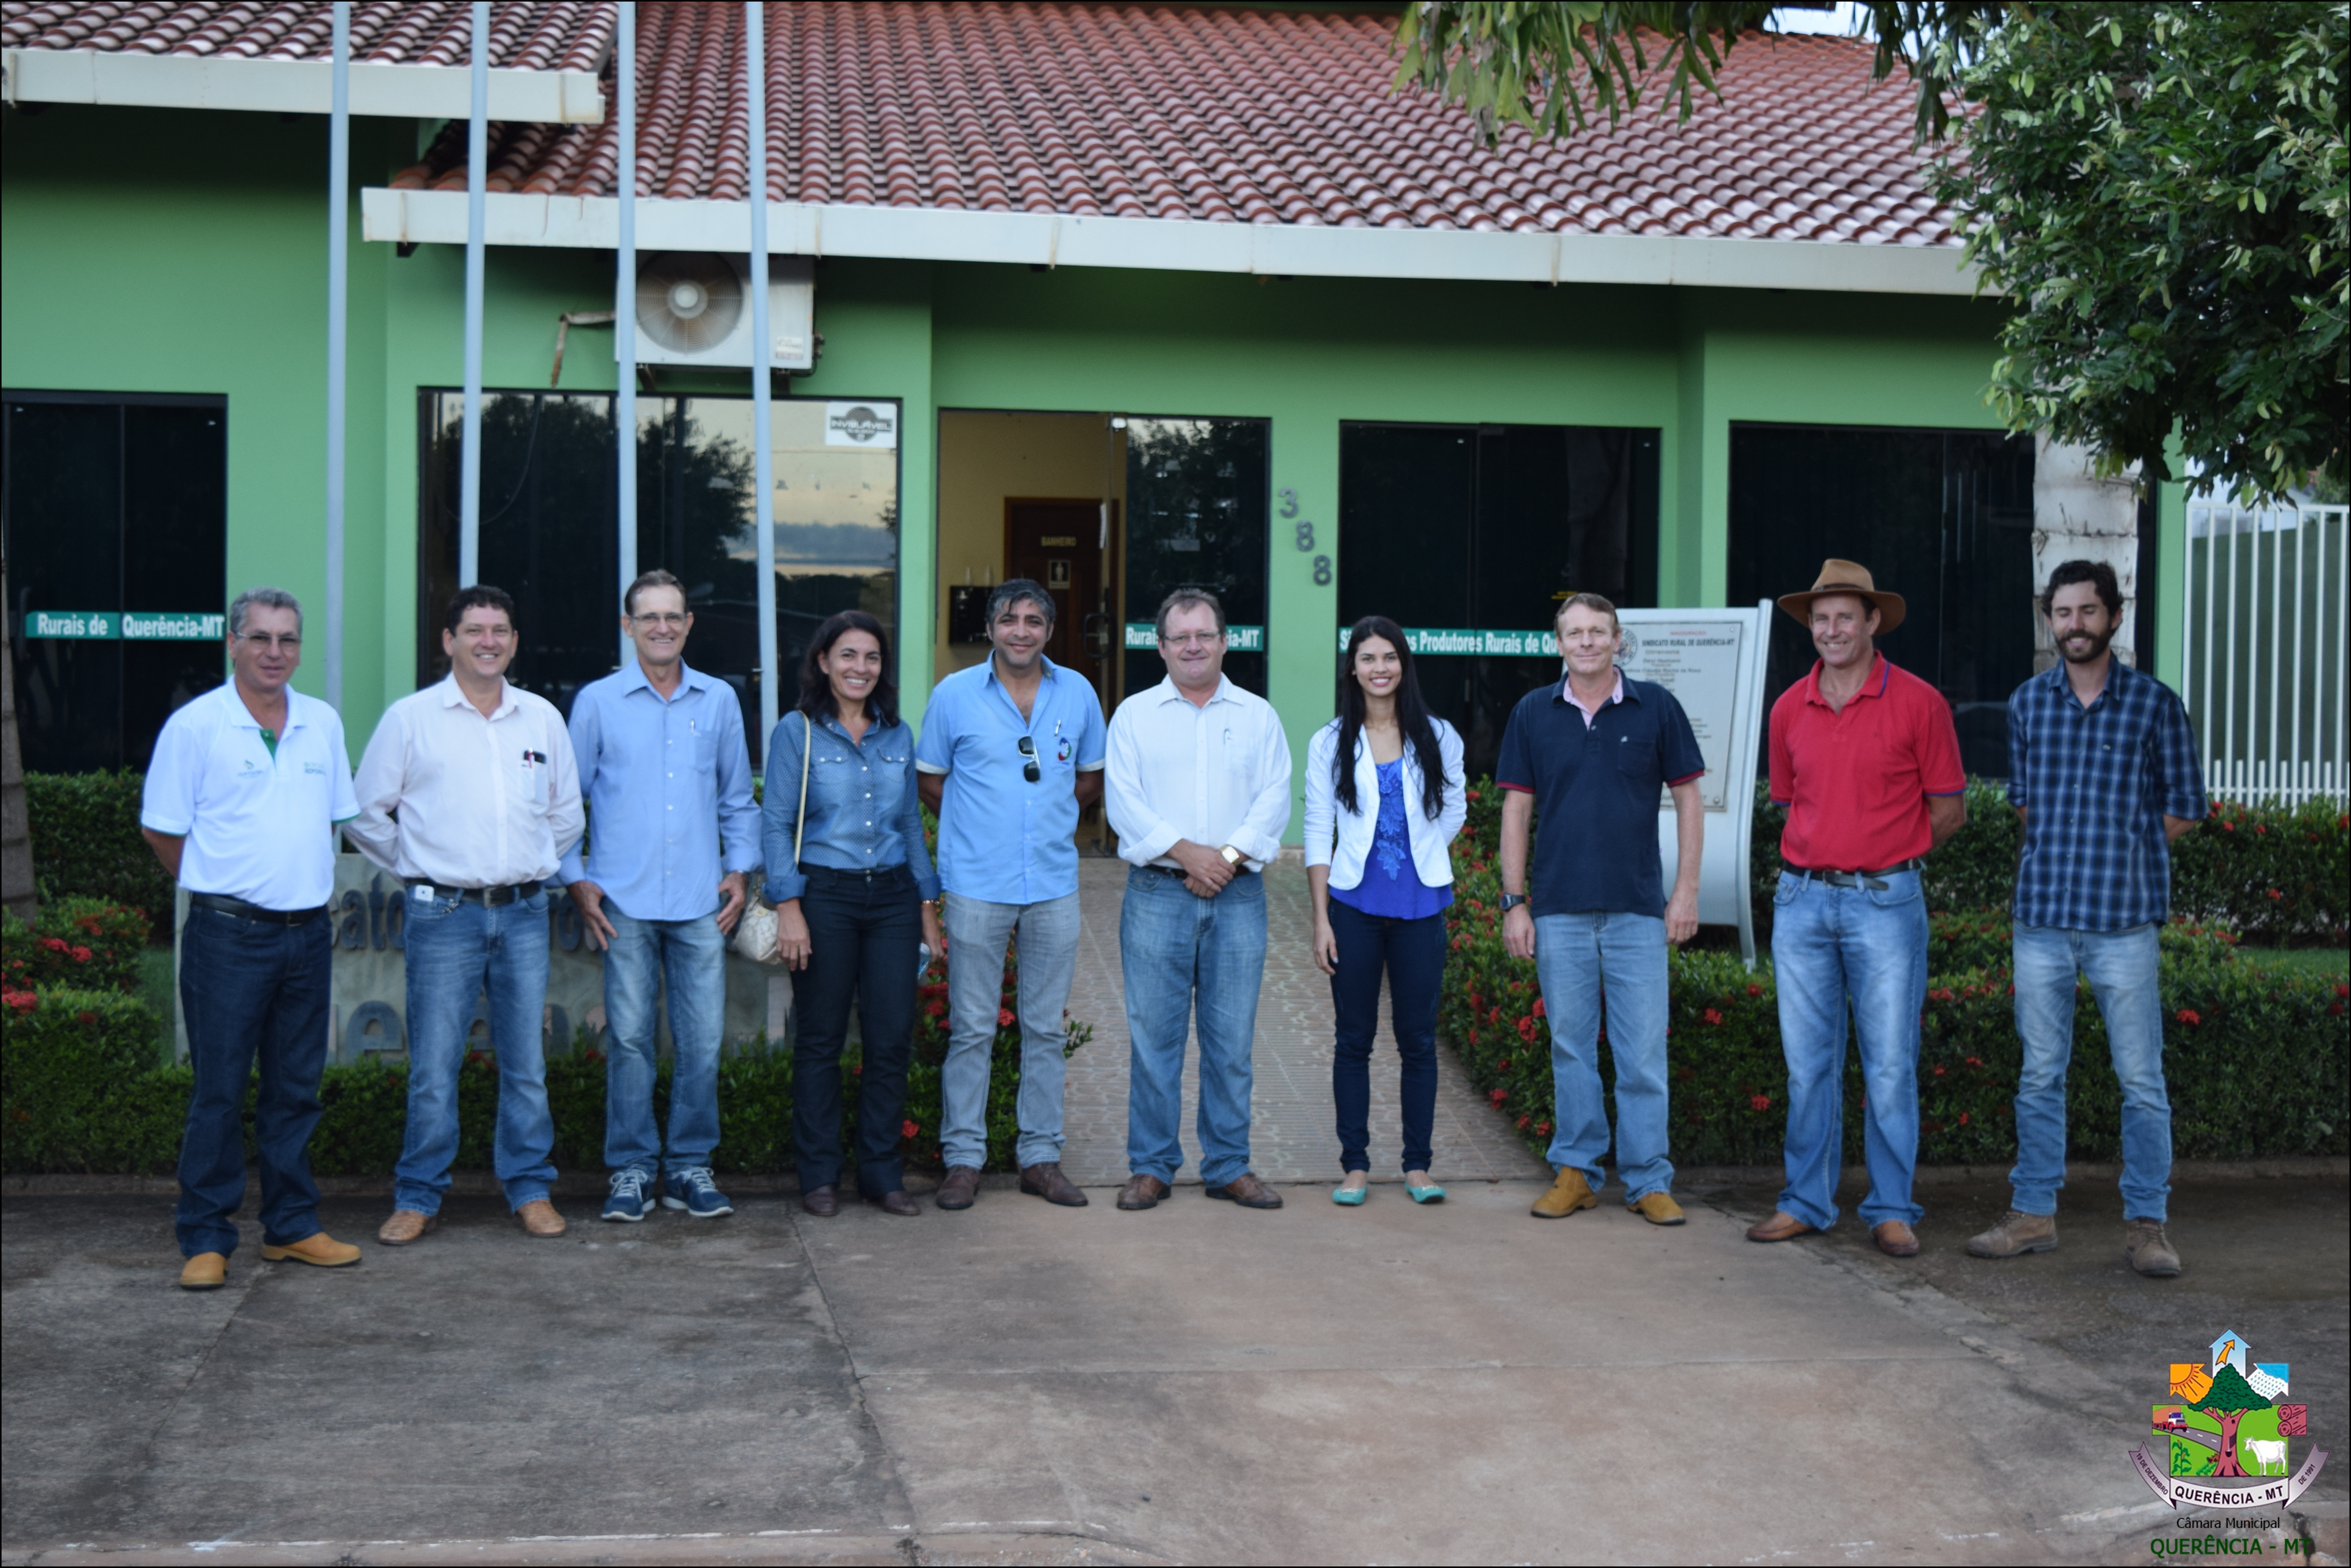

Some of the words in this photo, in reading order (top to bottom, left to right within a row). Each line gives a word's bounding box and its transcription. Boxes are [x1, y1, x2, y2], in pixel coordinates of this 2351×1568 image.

[38, 613, 85, 635] Rurais
[89, 614, 108, 635] de
[122, 614, 225, 637] Querência-MT
[1125, 627, 1158, 646] Rurai
[1420, 630, 1483, 652] Produtores
[1485, 631, 1522, 653] Rurais
[1525, 632, 1539, 653] de
